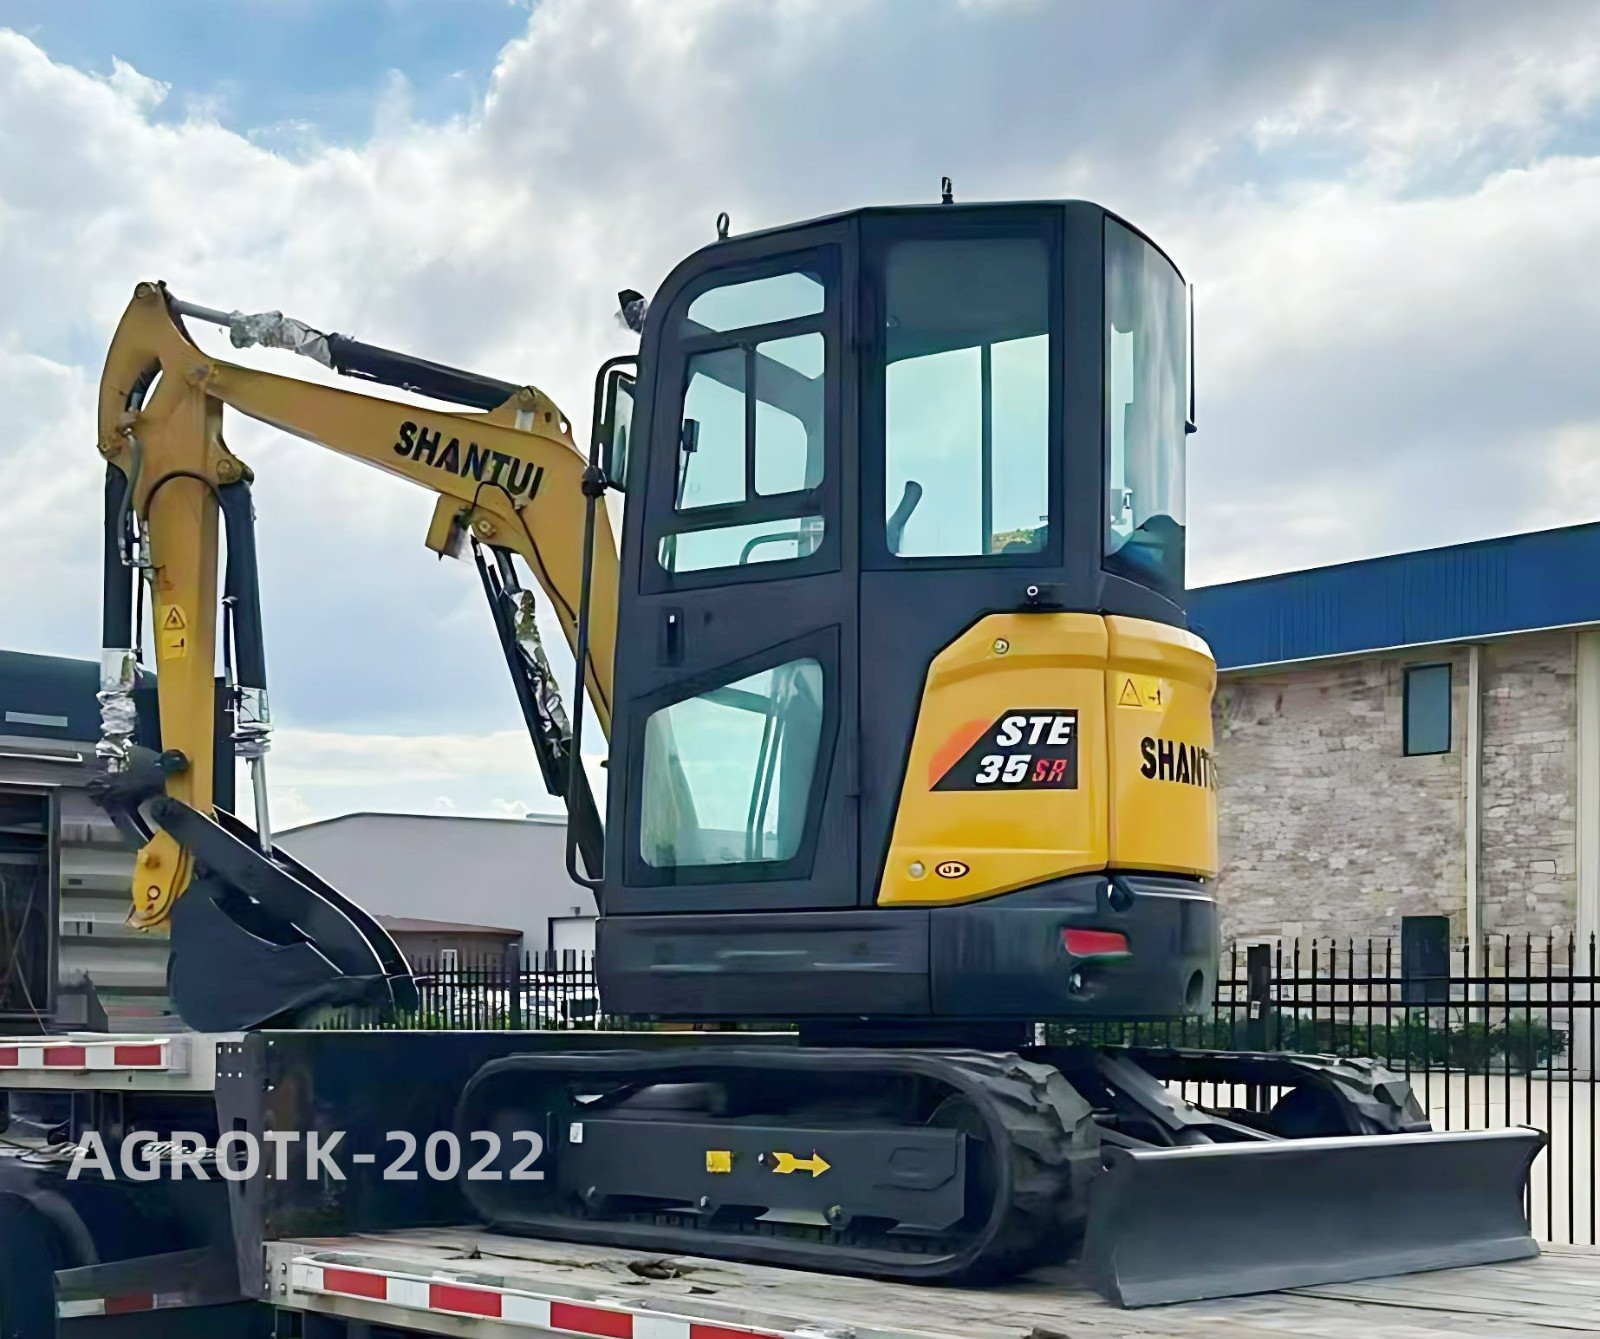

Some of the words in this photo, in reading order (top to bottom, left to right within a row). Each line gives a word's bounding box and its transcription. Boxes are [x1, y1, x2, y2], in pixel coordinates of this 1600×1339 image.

[393, 421, 545, 501] SHANTUI
[996, 716, 1076, 747] STE
[975, 754, 1032, 784] 35
[1032, 759, 1068, 782] SR
